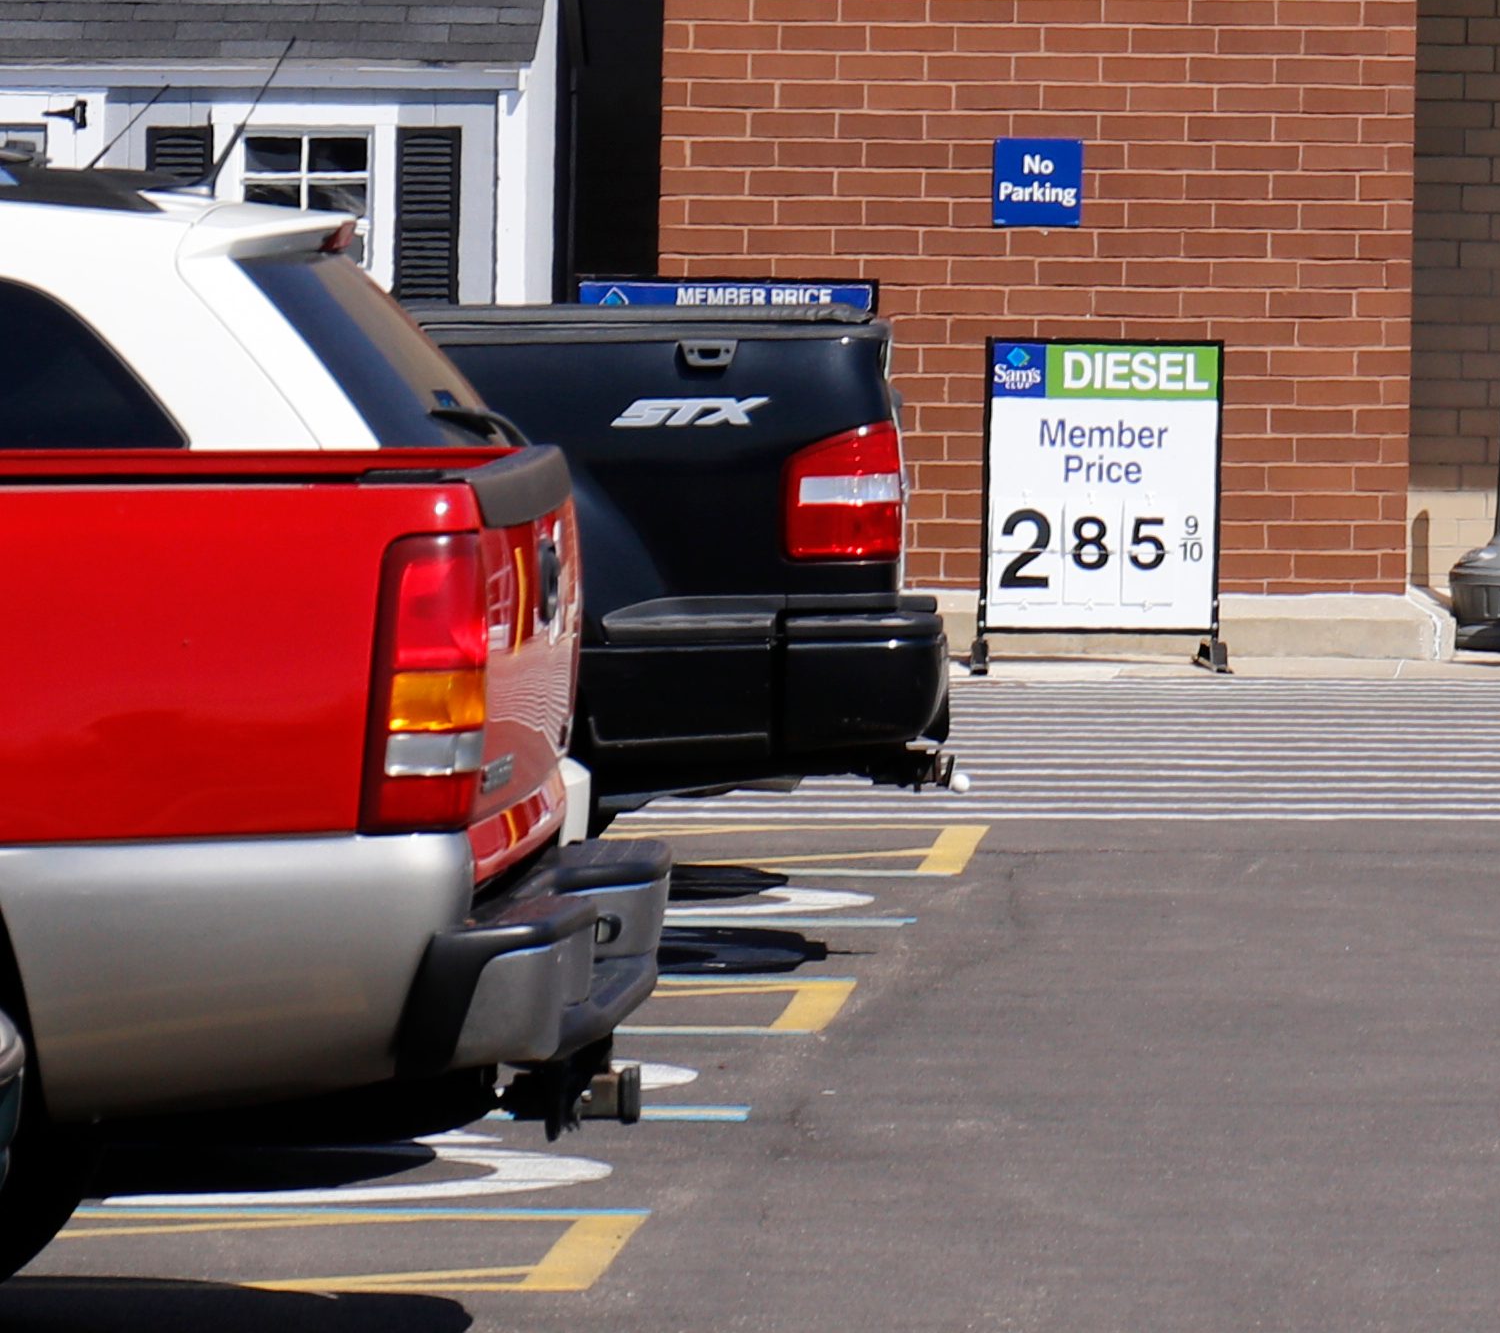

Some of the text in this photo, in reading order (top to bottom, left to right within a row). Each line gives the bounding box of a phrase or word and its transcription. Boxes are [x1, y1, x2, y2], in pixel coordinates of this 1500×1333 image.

[1023, 153, 1055, 175] No
[998, 180, 1078, 208] Parking
[675, 287, 766, 306] MEMBER
[993, 363, 1042, 384] Sam's
[1062, 350, 1210, 391] DIESEL
[609, 396, 771, 427] STX
[1039, 418, 1168, 449] Member
[1063, 454, 1143, 484] Price
